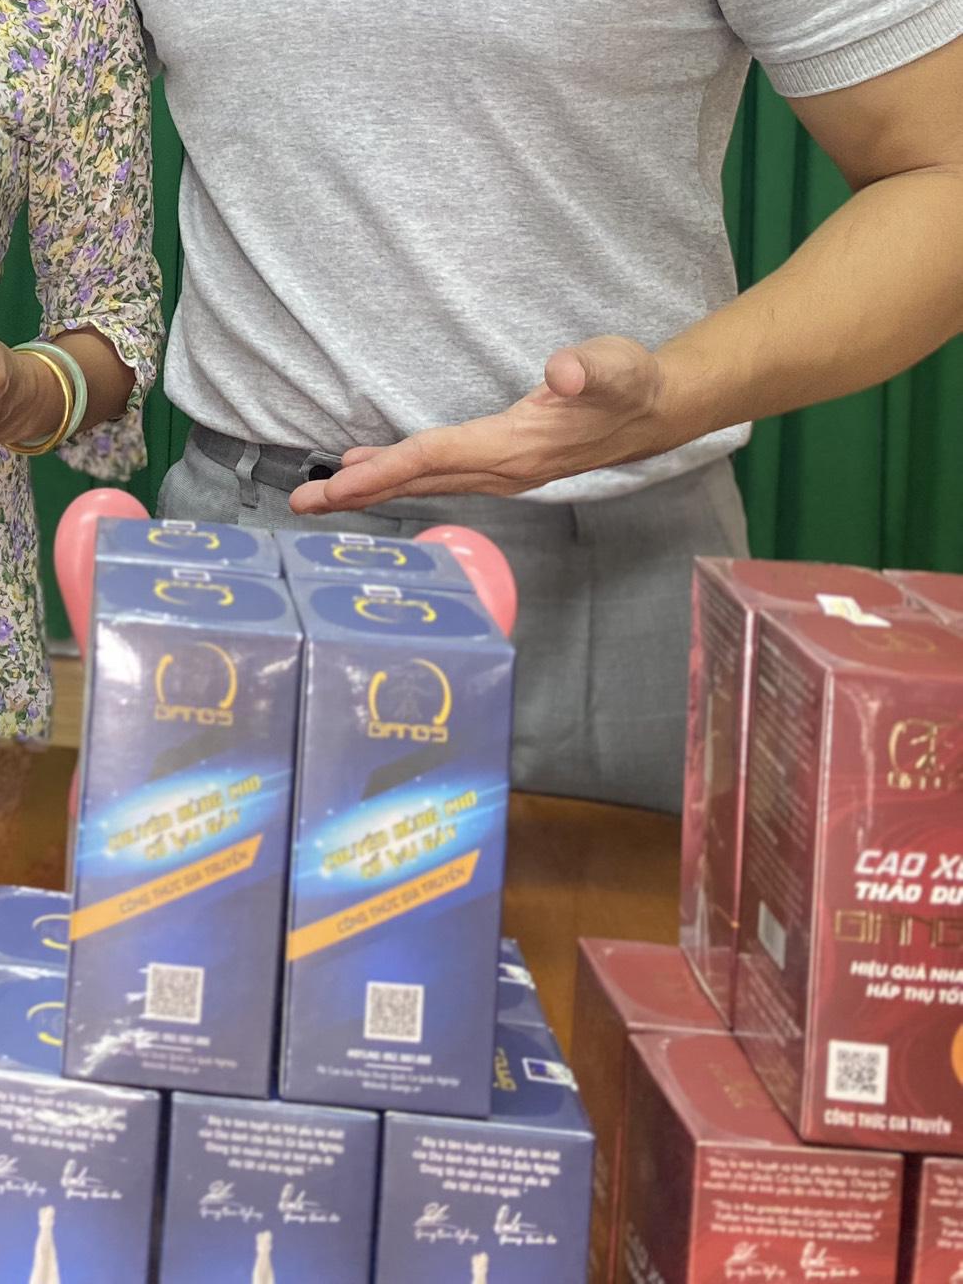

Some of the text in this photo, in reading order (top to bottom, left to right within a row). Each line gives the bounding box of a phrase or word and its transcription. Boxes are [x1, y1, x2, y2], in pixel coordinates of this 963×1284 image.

[855, 849, 963, 881] CAO X
[854, 877, 923, 904] THẢO
[850, 961, 889, 979] HIỆU
[891, 963, 926, 982] QUẢ
[866, 982, 901, 1000] HẤP
[904, 986, 935, 1006] THỤ
